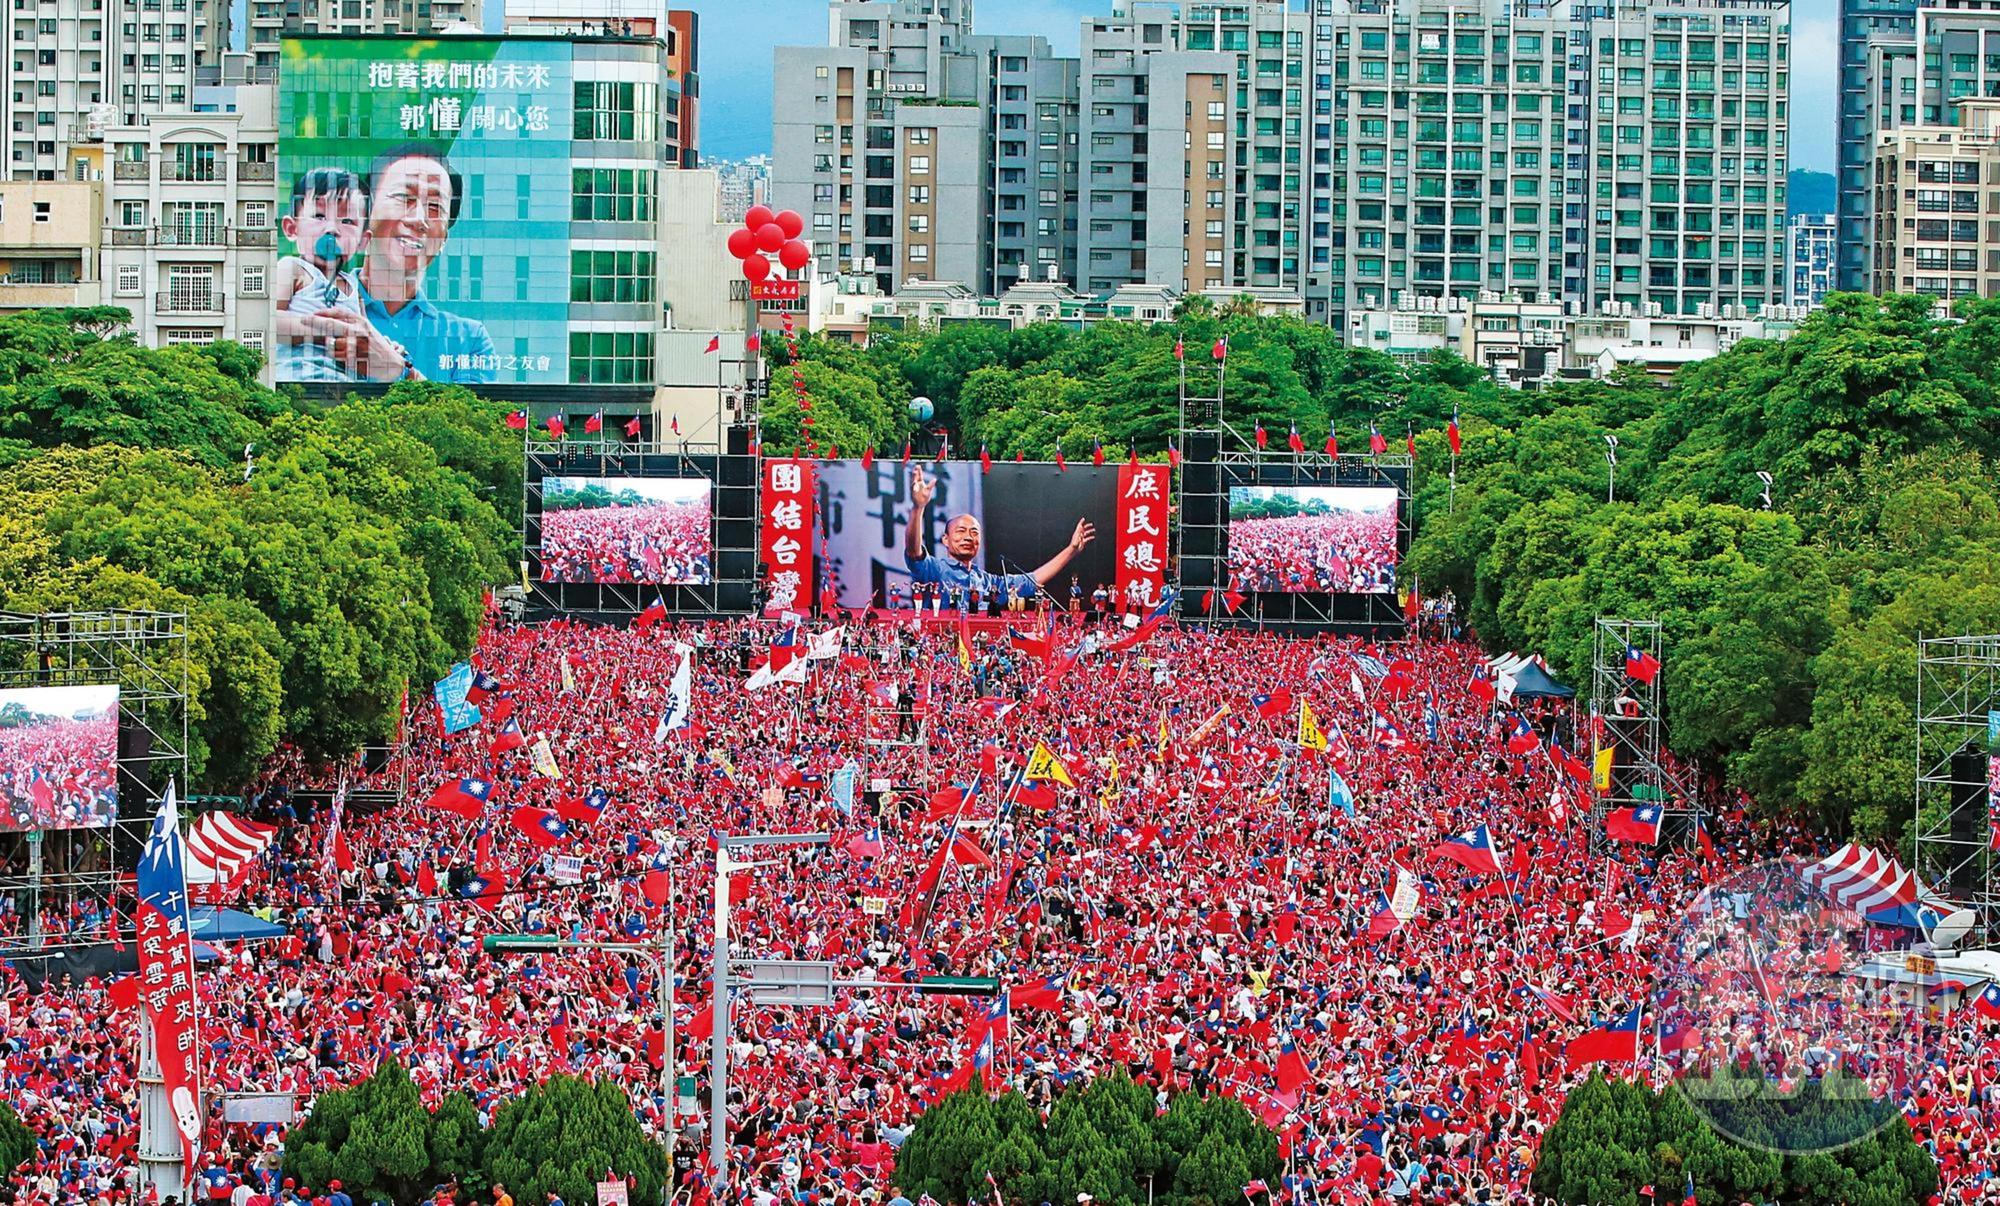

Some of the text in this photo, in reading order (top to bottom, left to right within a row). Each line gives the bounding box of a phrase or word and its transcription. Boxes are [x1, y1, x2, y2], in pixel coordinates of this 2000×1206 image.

[368, 63, 551, 89] 抱著我們的未來
[400, 97, 549, 131] 郭懂 關心您
[771, 464, 802, 605] 團結台灣
[1124, 469, 1161, 608] 庶民總統
